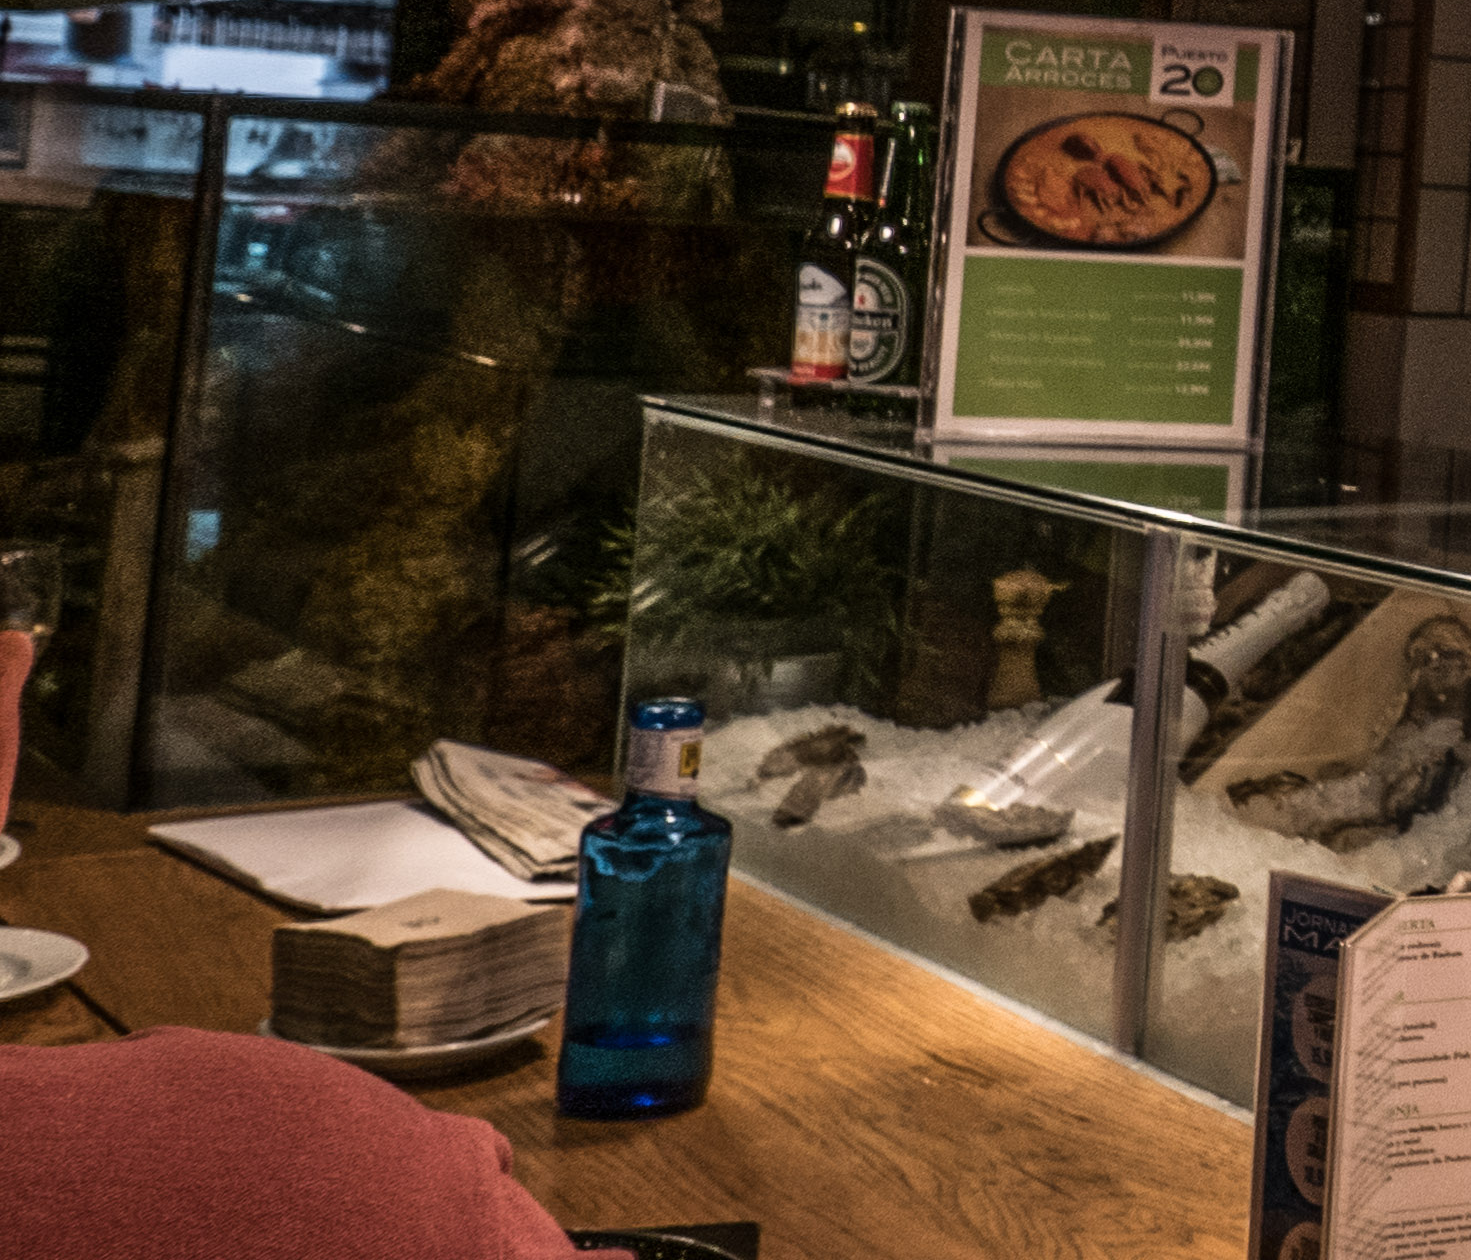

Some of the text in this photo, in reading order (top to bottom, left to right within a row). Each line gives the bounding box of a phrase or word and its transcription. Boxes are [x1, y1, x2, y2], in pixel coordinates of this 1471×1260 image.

[1004, 40, 1132, 72] CARTA
[1003, 65, 1132, 90] ARROCES
[1159, 63, 1224, 97] 20
[1284, 907, 1357, 935] JORNA
